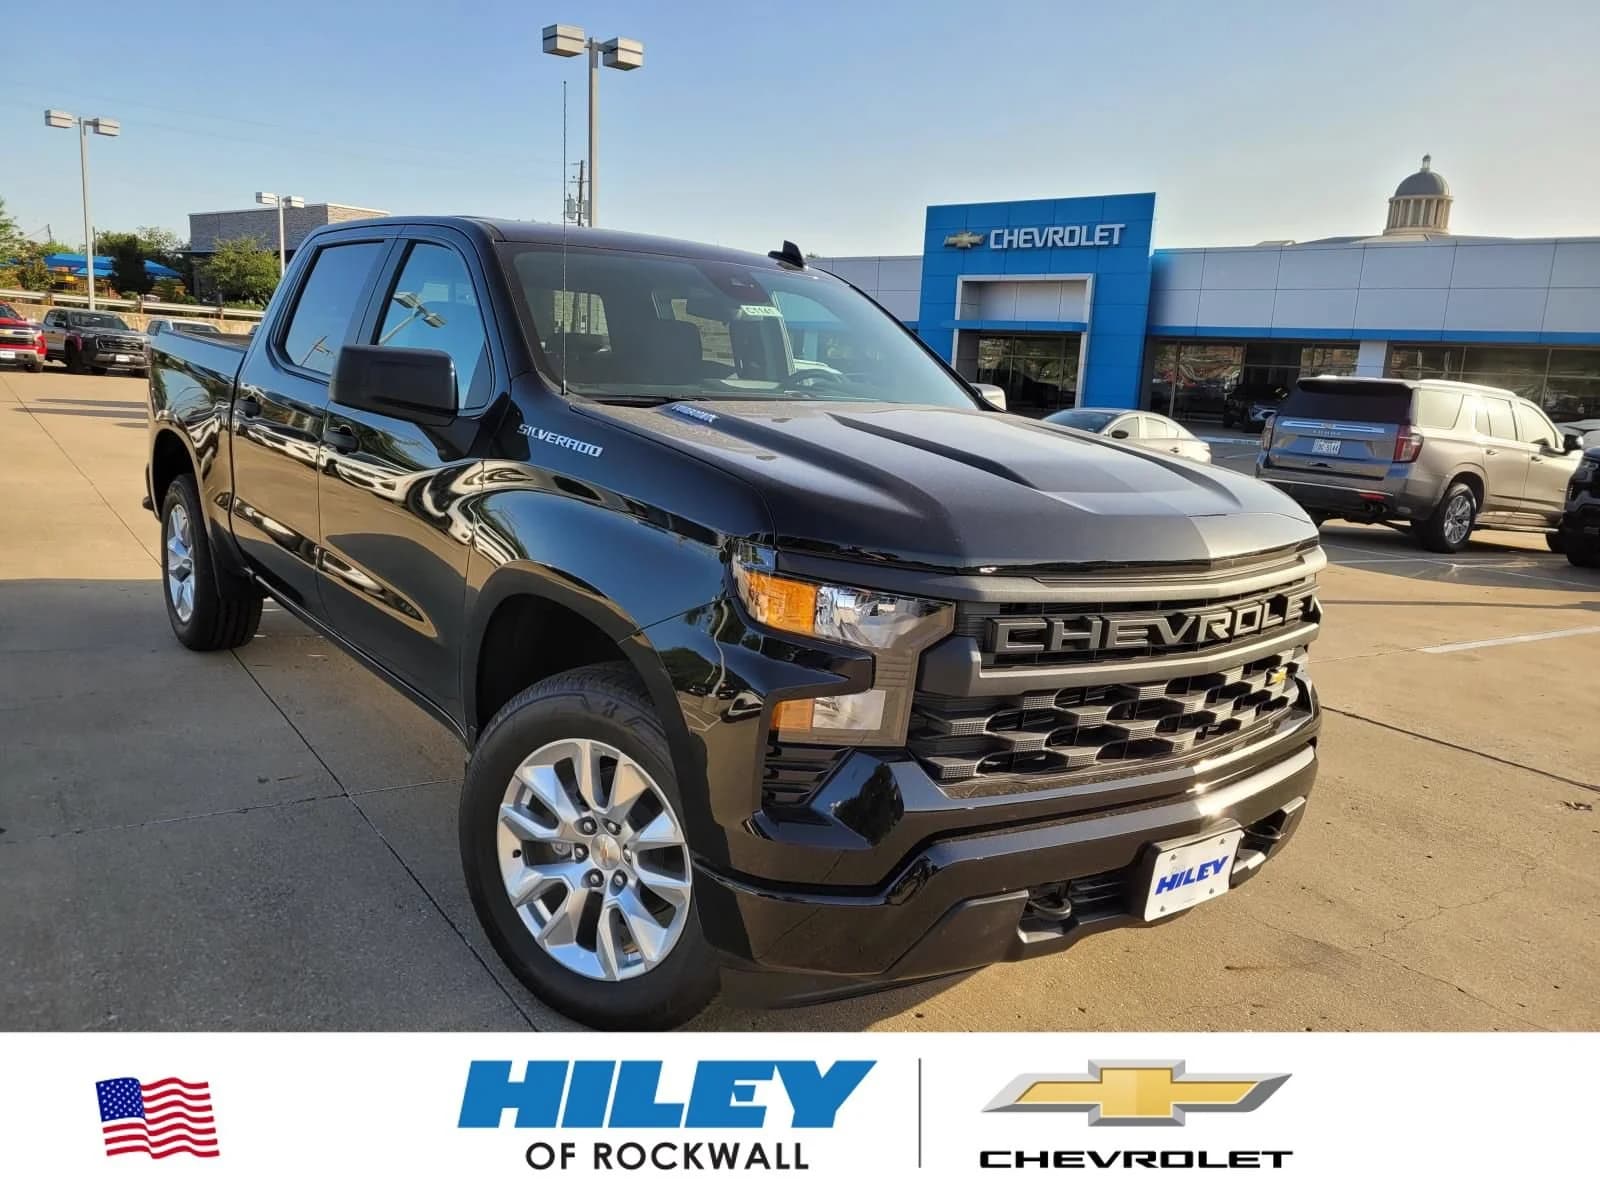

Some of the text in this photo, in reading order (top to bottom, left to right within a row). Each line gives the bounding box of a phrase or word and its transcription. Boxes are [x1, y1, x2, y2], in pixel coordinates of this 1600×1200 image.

[989, 223, 1126, 250] CHEVROLET
[516, 423, 604, 458] SILVERADO
[1154, 855, 1230, 896] HILEY
